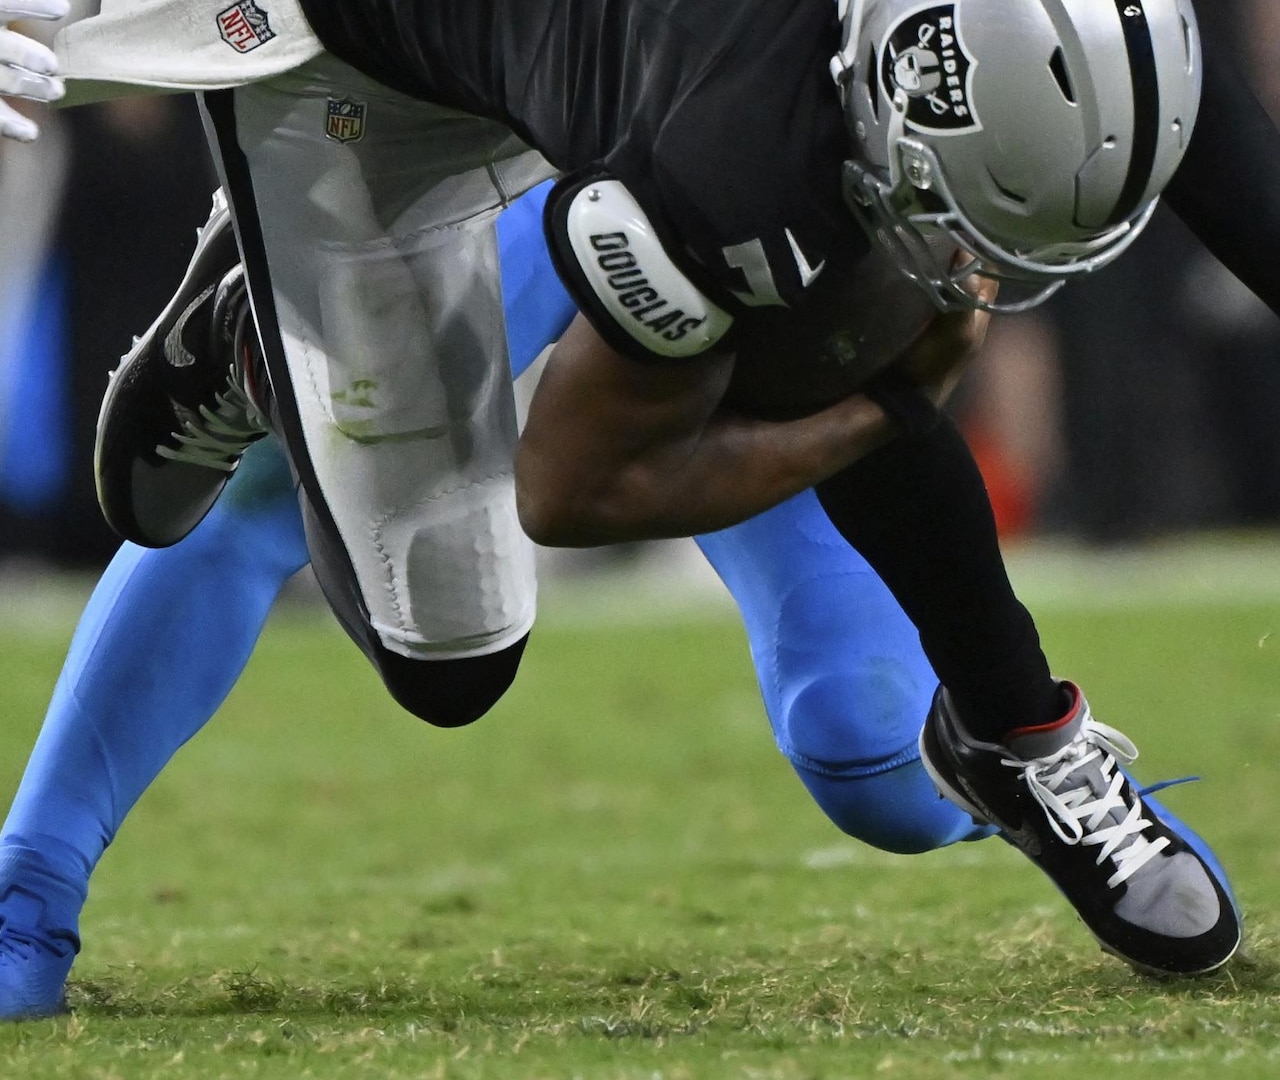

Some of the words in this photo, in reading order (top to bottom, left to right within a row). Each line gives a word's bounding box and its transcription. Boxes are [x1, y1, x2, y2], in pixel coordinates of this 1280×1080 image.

[220, 9, 257, 50] NFL
[939, 16, 969, 117] RAIDERS
[329, 116, 359, 136] NFL
[590, 231, 707, 342] DOUGLAS
